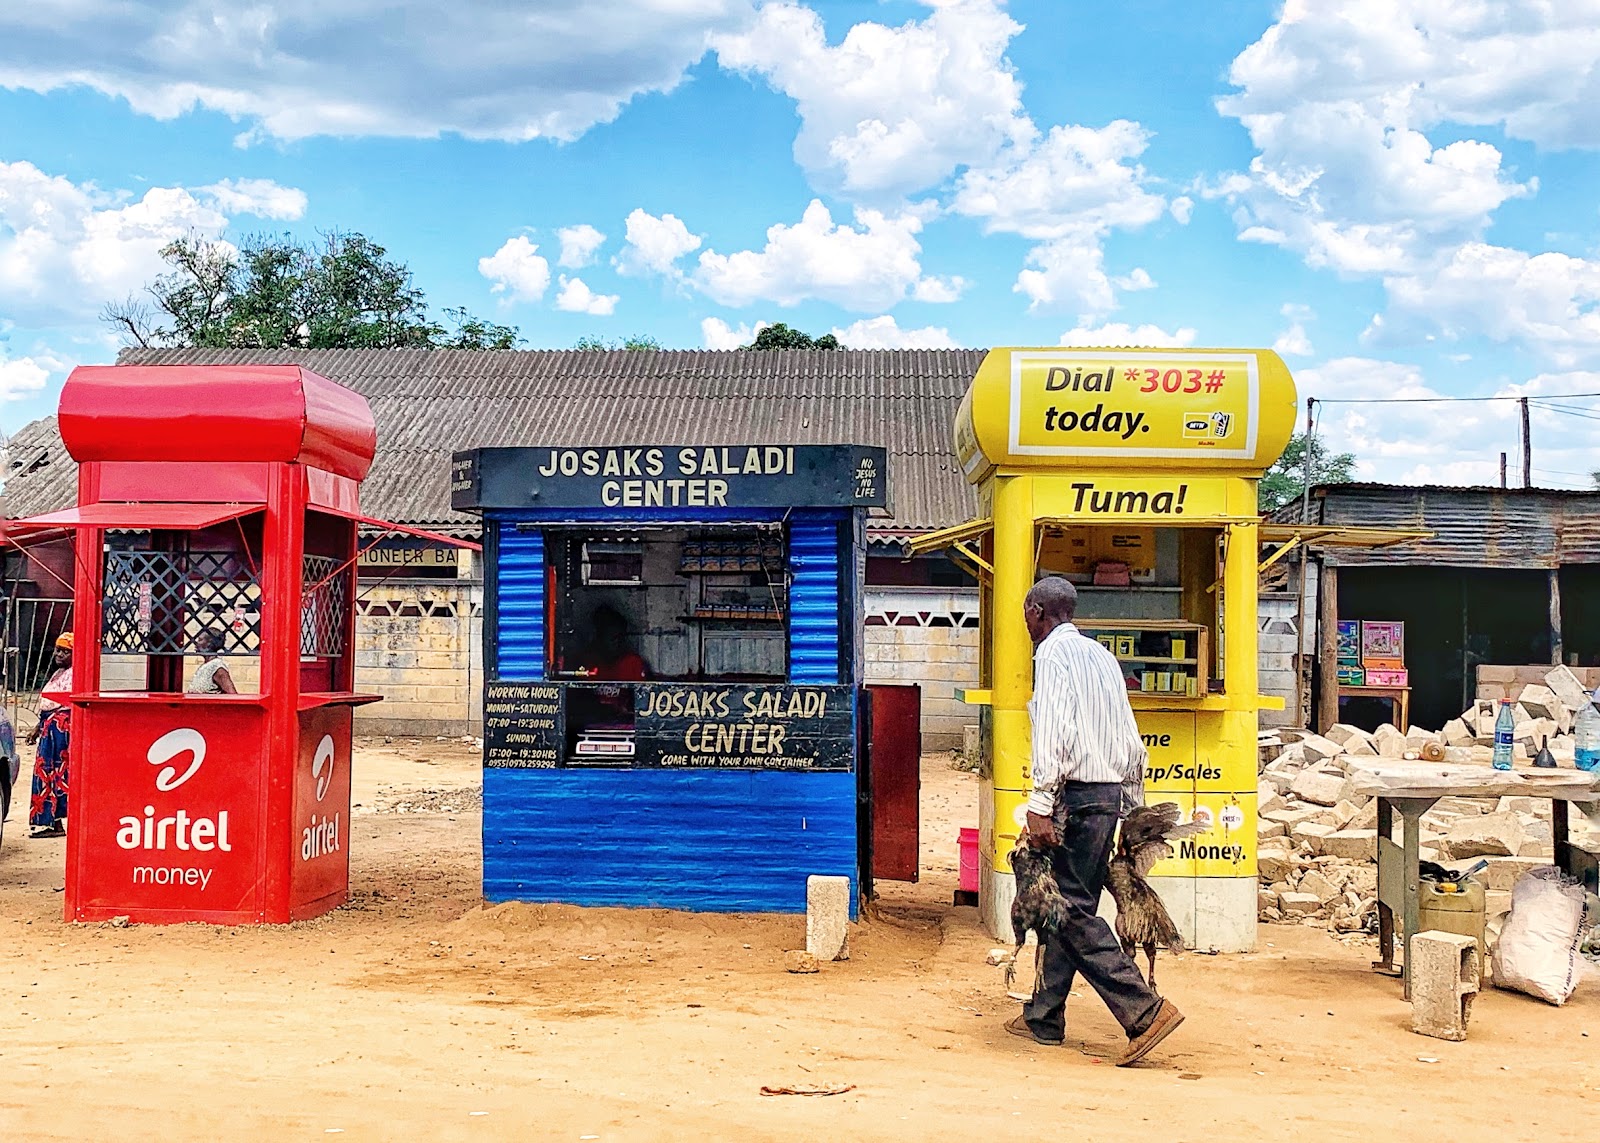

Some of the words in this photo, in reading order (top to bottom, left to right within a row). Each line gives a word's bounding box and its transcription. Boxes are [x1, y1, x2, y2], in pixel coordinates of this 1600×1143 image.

[1045, 366, 1115, 392] Dial
[1045, 403, 1150, 440] today.
[538, 448, 664, 477] JOSAKS
[678, 447, 794, 475] SALADI
[860, 457, 874, 469] NO
[855, 468, 877, 480] JESUS
[860, 478, 872, 488] NO
[601, 479, 729, 507] CENTER
[854, 487, 876, 498] LIFE
[1071, 483, 1188, 514] Tuma!
[362, 549, 424, 563] IONEER
[435, 549, 456, 563] BA
[488, 686, 530, 699] WORKING
[530, 687, 559, 699] HOURS
[639, 690, 731, 718] JOSAKS
[742, 691, 828, 719] SALADI
[505, 733, 537, 744] SUNDAY
[684, 722, 786, 754] CENTER
[1141, 733, 1171, 747] me
[691, 755, 715, 766] WITH
[719, 755, 742, 766] YOUR
[743, 755, 763, 766] OWN
[1144, 764, 1222, 783] ap/Sales
[116, 805, 232, 852] airtel
[301, 812, 340, 861] airtel
[1180, 841, 1247, 864] Money.
[133, 866, 213, 891] money
